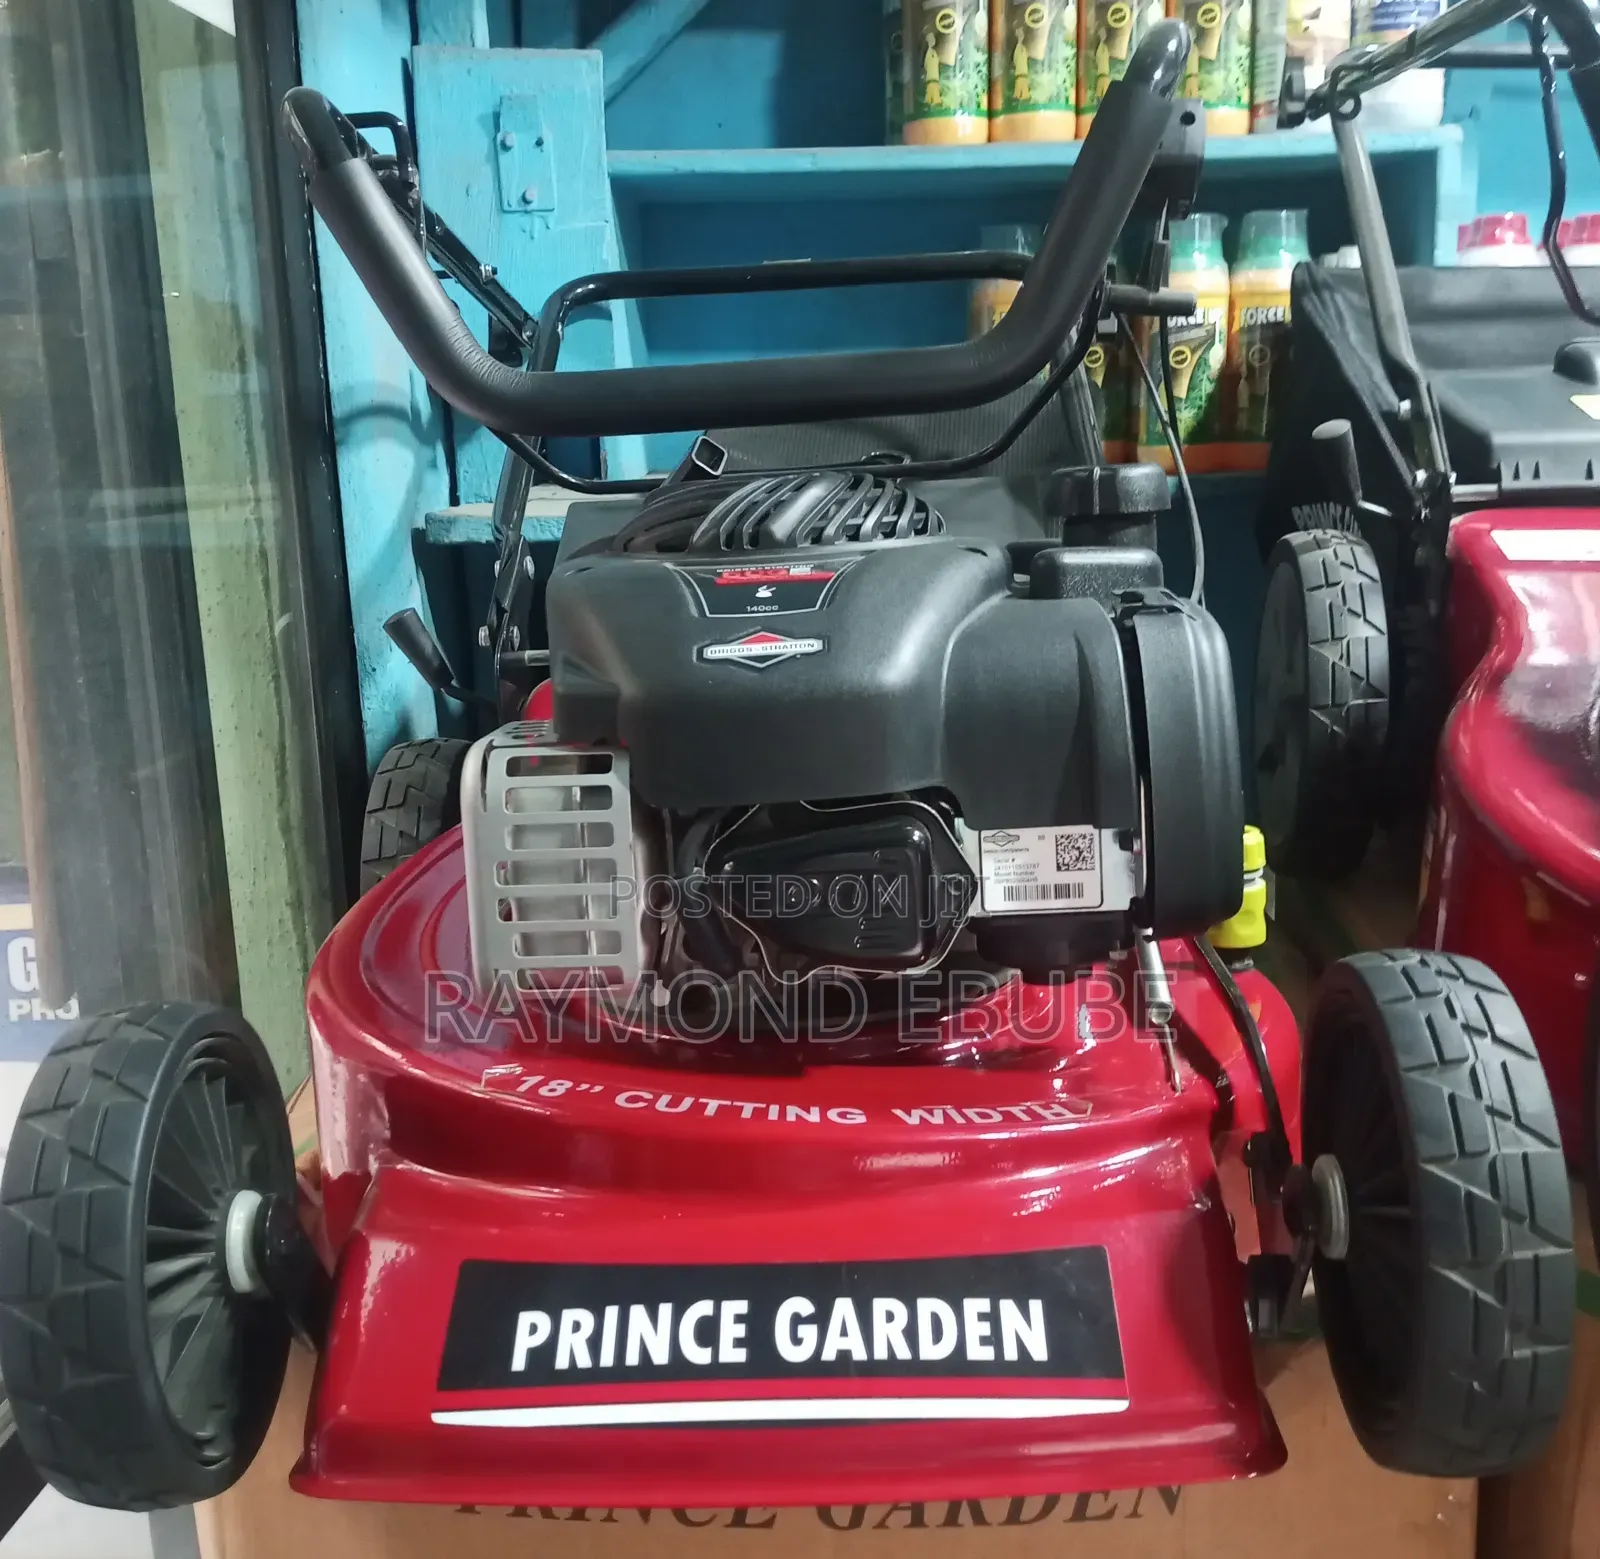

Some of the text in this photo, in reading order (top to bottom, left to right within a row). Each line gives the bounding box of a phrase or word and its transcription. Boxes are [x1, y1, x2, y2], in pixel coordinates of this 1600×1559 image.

[1167, 306, 1204, 328] ORCE
[1241, 306, 1284, 326] FORCE
[746, 604, 779, 613] 140cc
[710, 646, 752, 656] BRIGGS
[761, 642, 815, 652] STRATTON
[614, 1090, 867, 1125] CUTTING
[890, 1102, 1077, 1125] WIDTH
[511, 1296, 1049, 1373] PRINCE GARDEN
